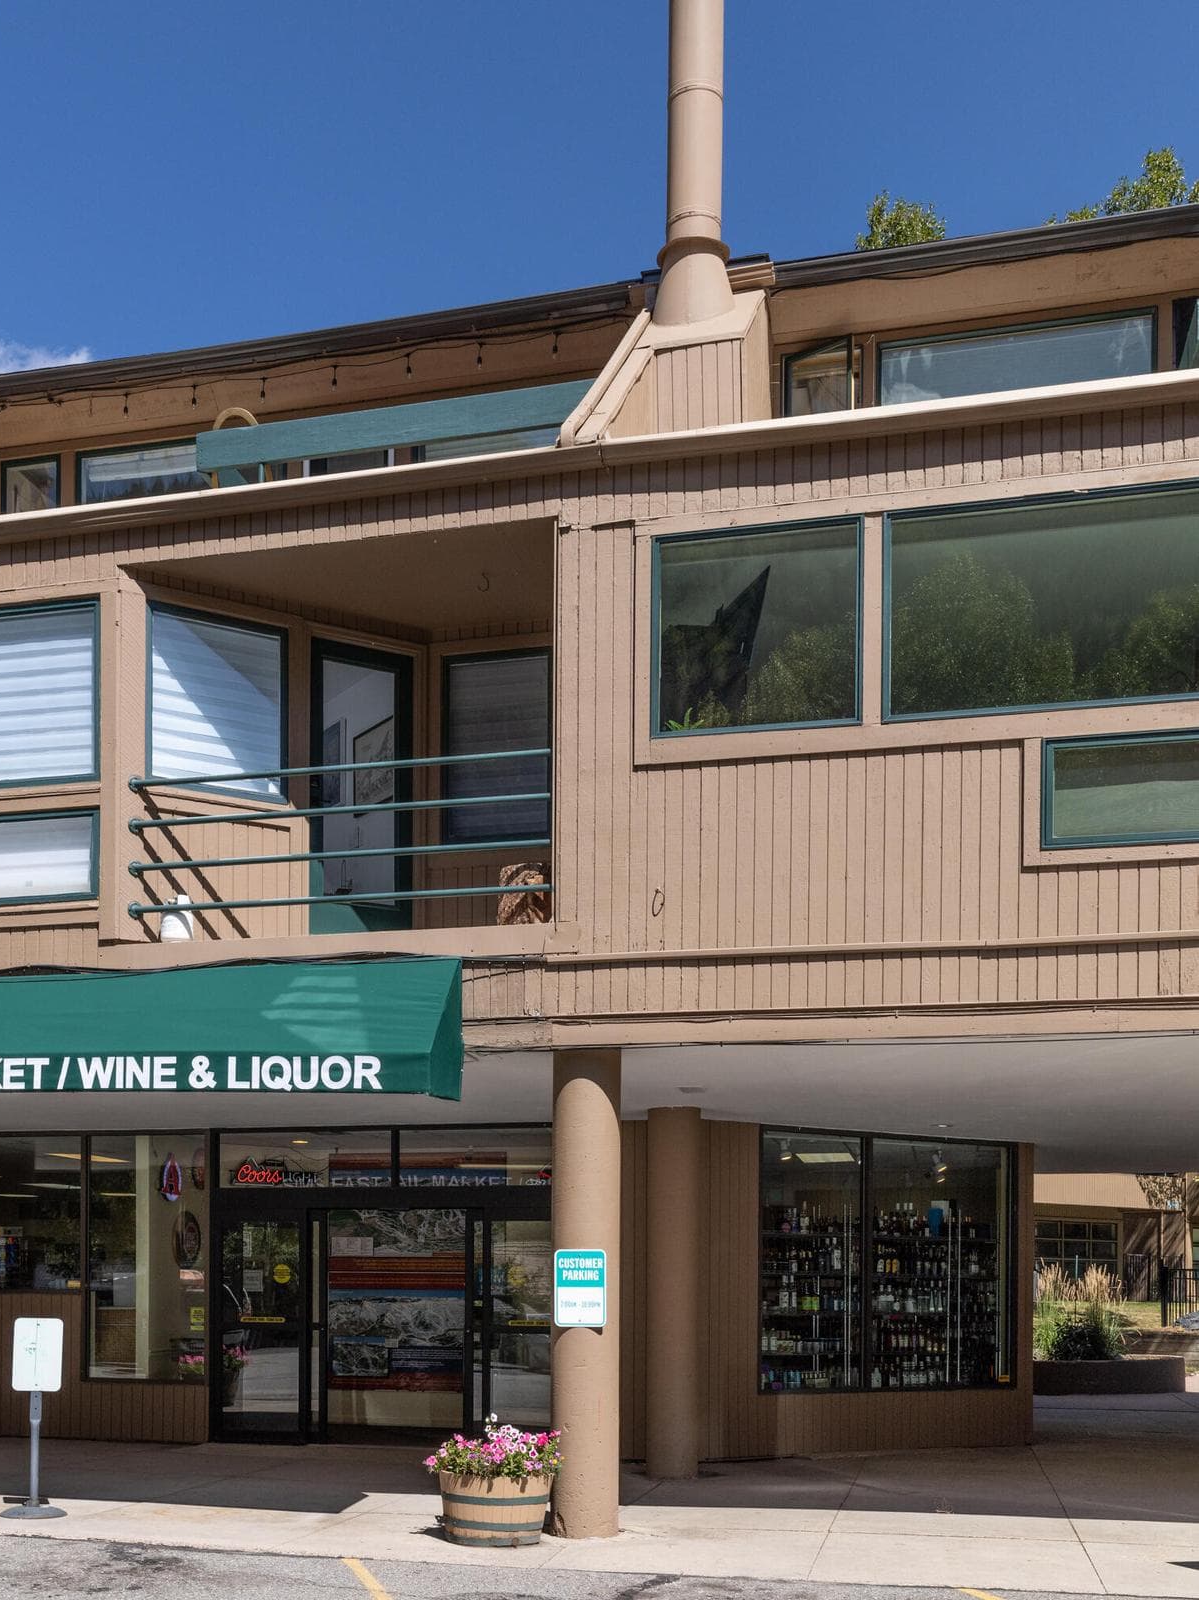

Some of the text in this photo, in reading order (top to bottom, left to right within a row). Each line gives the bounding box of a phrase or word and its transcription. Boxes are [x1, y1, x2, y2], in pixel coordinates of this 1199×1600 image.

[78, 1056, 177, 1090] WINE
[188, 1055, 217, 1088] &
[227, 1055, 383, 1092] LIQUOR
[237, 1164, 284, 1183] Coors
[558, 1257, 603, 1269] CUSTOMER
[562, 1269, 600, 1281] PARKING
